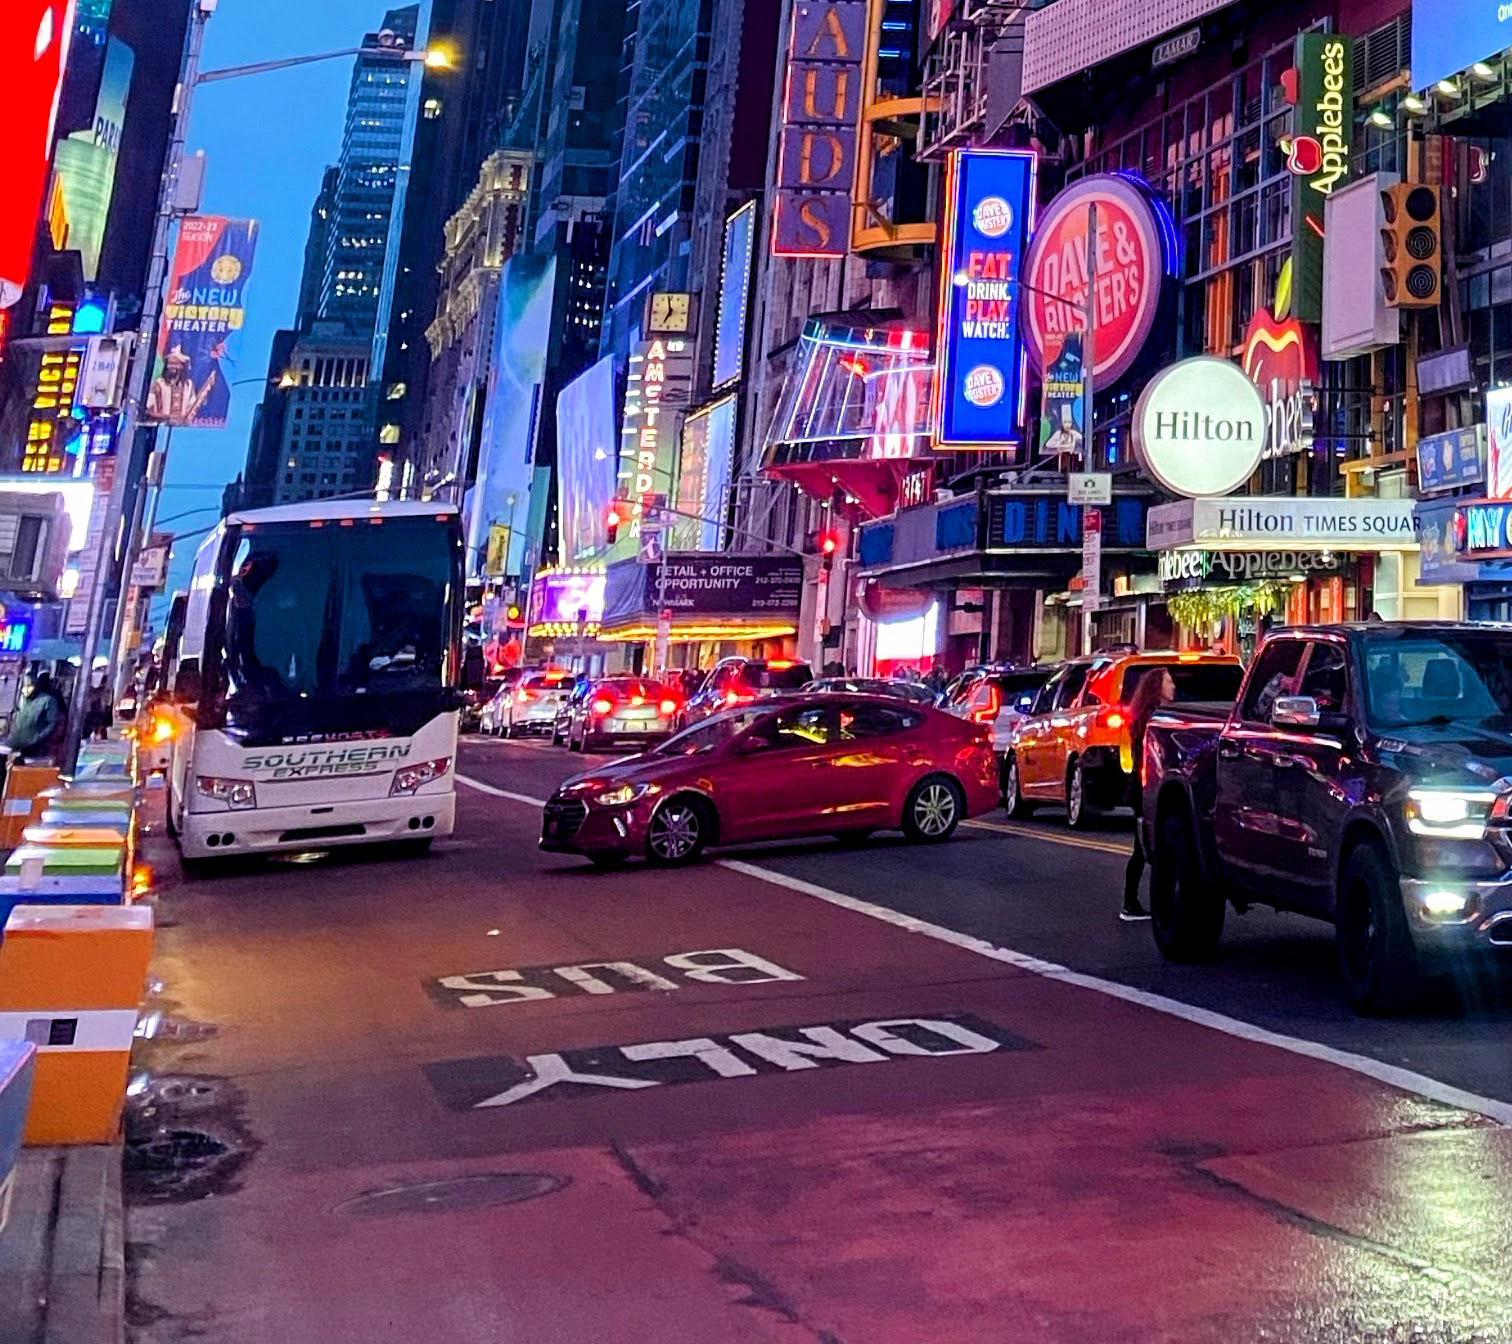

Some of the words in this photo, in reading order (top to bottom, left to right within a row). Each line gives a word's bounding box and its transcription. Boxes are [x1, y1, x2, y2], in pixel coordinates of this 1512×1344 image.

[1311, 40, 1347, 197] Applebee's
[1043, 226, 1109, 306] DAVE
[1113, 220, 1137, 265] &
[193, 288, 238, 304] NEW
[166, 319, 227, 332] THEATER
[1154, 411, 1254, 441] Hilton
[1219, 509, 1293, 532] Hilton
[1304, 516, 1356, 532] TIMES
[1362, 516, 1421, 534] SQUAR
[656, 566, 697, 576] RETAIL
[710, 565, 753, 576] OFFICE
[655, 578, 740, 589] OPPORTUNITY
[652, 598, 695, 607] NWMARK
[242, 744, 411, 770] SOUTHERN
[274, 762, 378, 778] EXPRESS
[438, 948, 806, 1008] BUS
[475, 1018, 1001, 1108] ONLY
